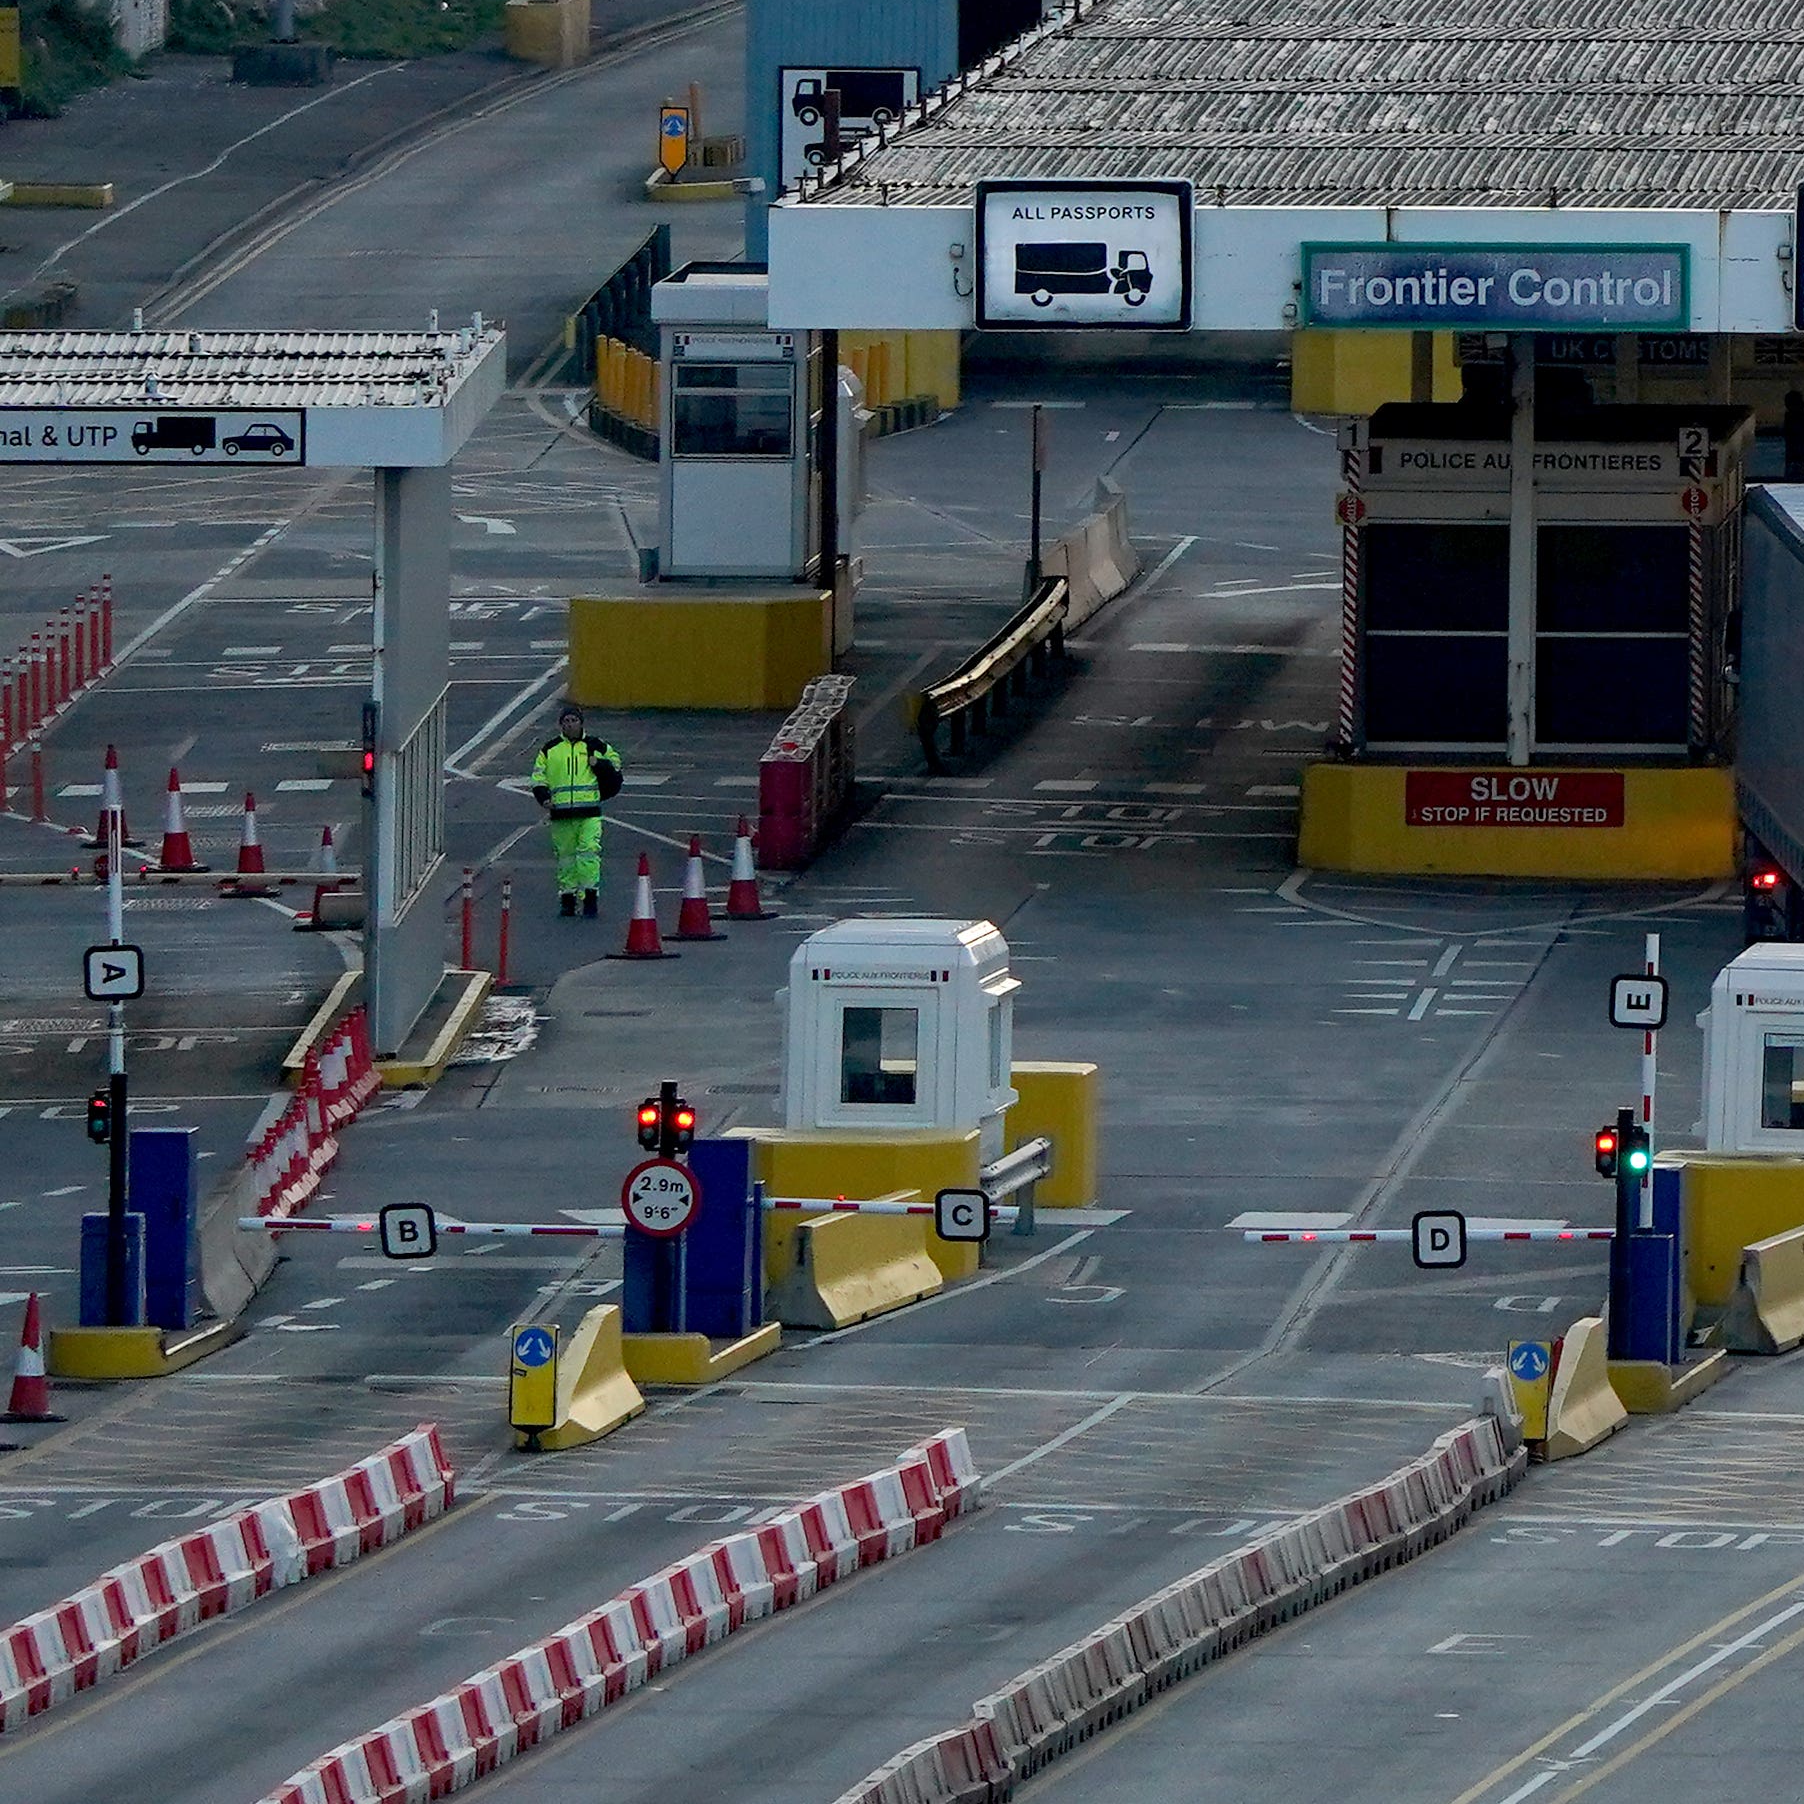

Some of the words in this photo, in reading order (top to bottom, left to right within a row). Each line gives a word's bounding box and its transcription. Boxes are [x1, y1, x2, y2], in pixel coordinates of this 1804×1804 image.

[1012, 207, 1045, 220] ALL
[1051, 206, 1155, 220] PASSPORTS
[1318, 268, 1495, 308] Frontier
[1507, 268, 1673, 308] Control
[1552, 341, 1585, 359] UK
[42, 426, 59, 446] &
[68, 426, 118, 446] UTP
[1347, 423, 1359, 446] 1
[1684, 430, 1703, 455] 2
[1400, 453, 1476, 470] POLICE
[1483, 453, 1512, 470] AU
[1532, 453, 1662, 471] FRONTIERES
[1471, 777, 1560, 802] SLOW
[1421, 806, 1469, 822] STOP
[1475, 807, 1490, 822] IF
[1496, 807, 1608, 824] REQUESTED
[102, 962, 126, 984] A
[1630, 992, 1651, 1012] E
[640, 1176, 684, 1193] 2.9m
[952, 1204, 974, 1227] C
[399, 1220, 419, 1242] B
[1431, 1227, 1451, 1251] D
